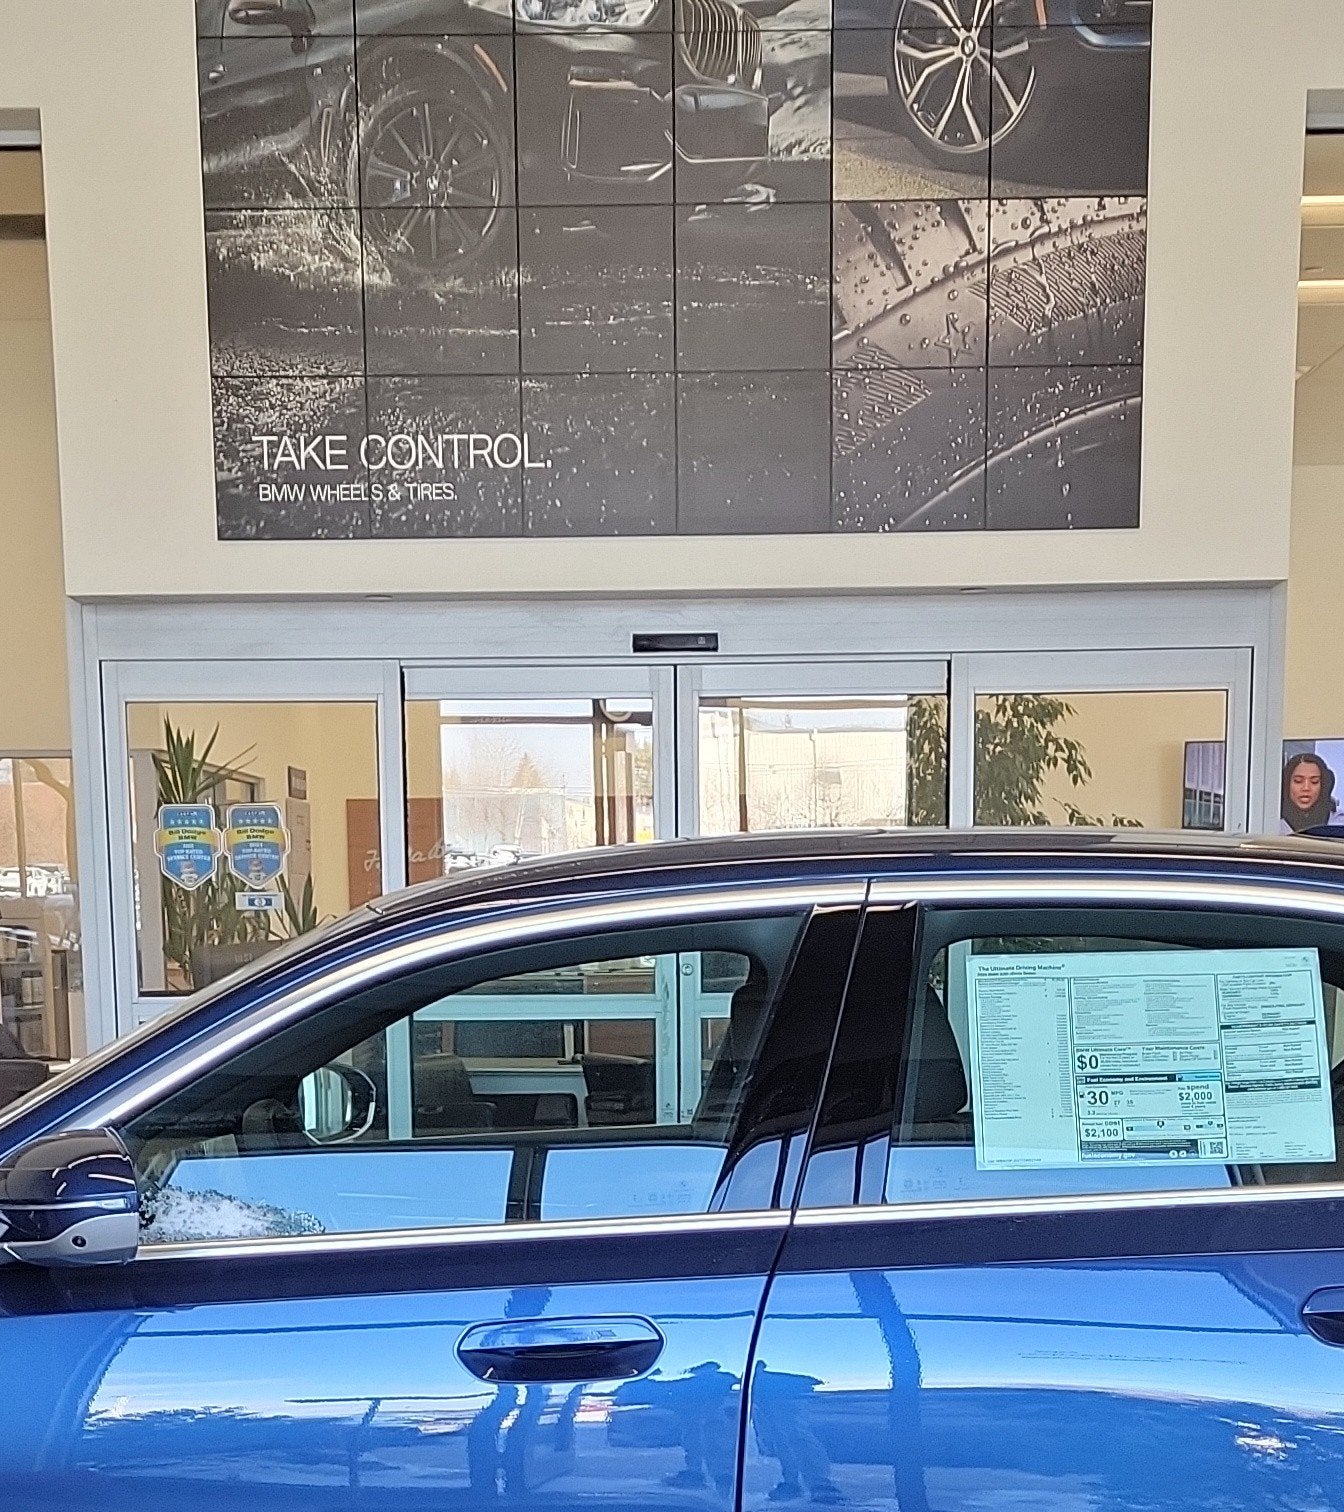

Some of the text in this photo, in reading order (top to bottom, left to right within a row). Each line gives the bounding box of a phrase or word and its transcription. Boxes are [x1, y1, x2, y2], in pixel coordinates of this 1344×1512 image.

[251, 432, 553, 471] TAKE CONTROL.
[258, 482, 458, 502] BMW WHEELS & TIRES.
[1076, 1053, 1099, 1071] $0
[1186, 1083, 1210, 1092] spend
[1086, 1090, 1109, 1105] 30
[1178, 1091, 1213, 1103] $2,000
[1084, 1128, 1119, 1139] $2,100
